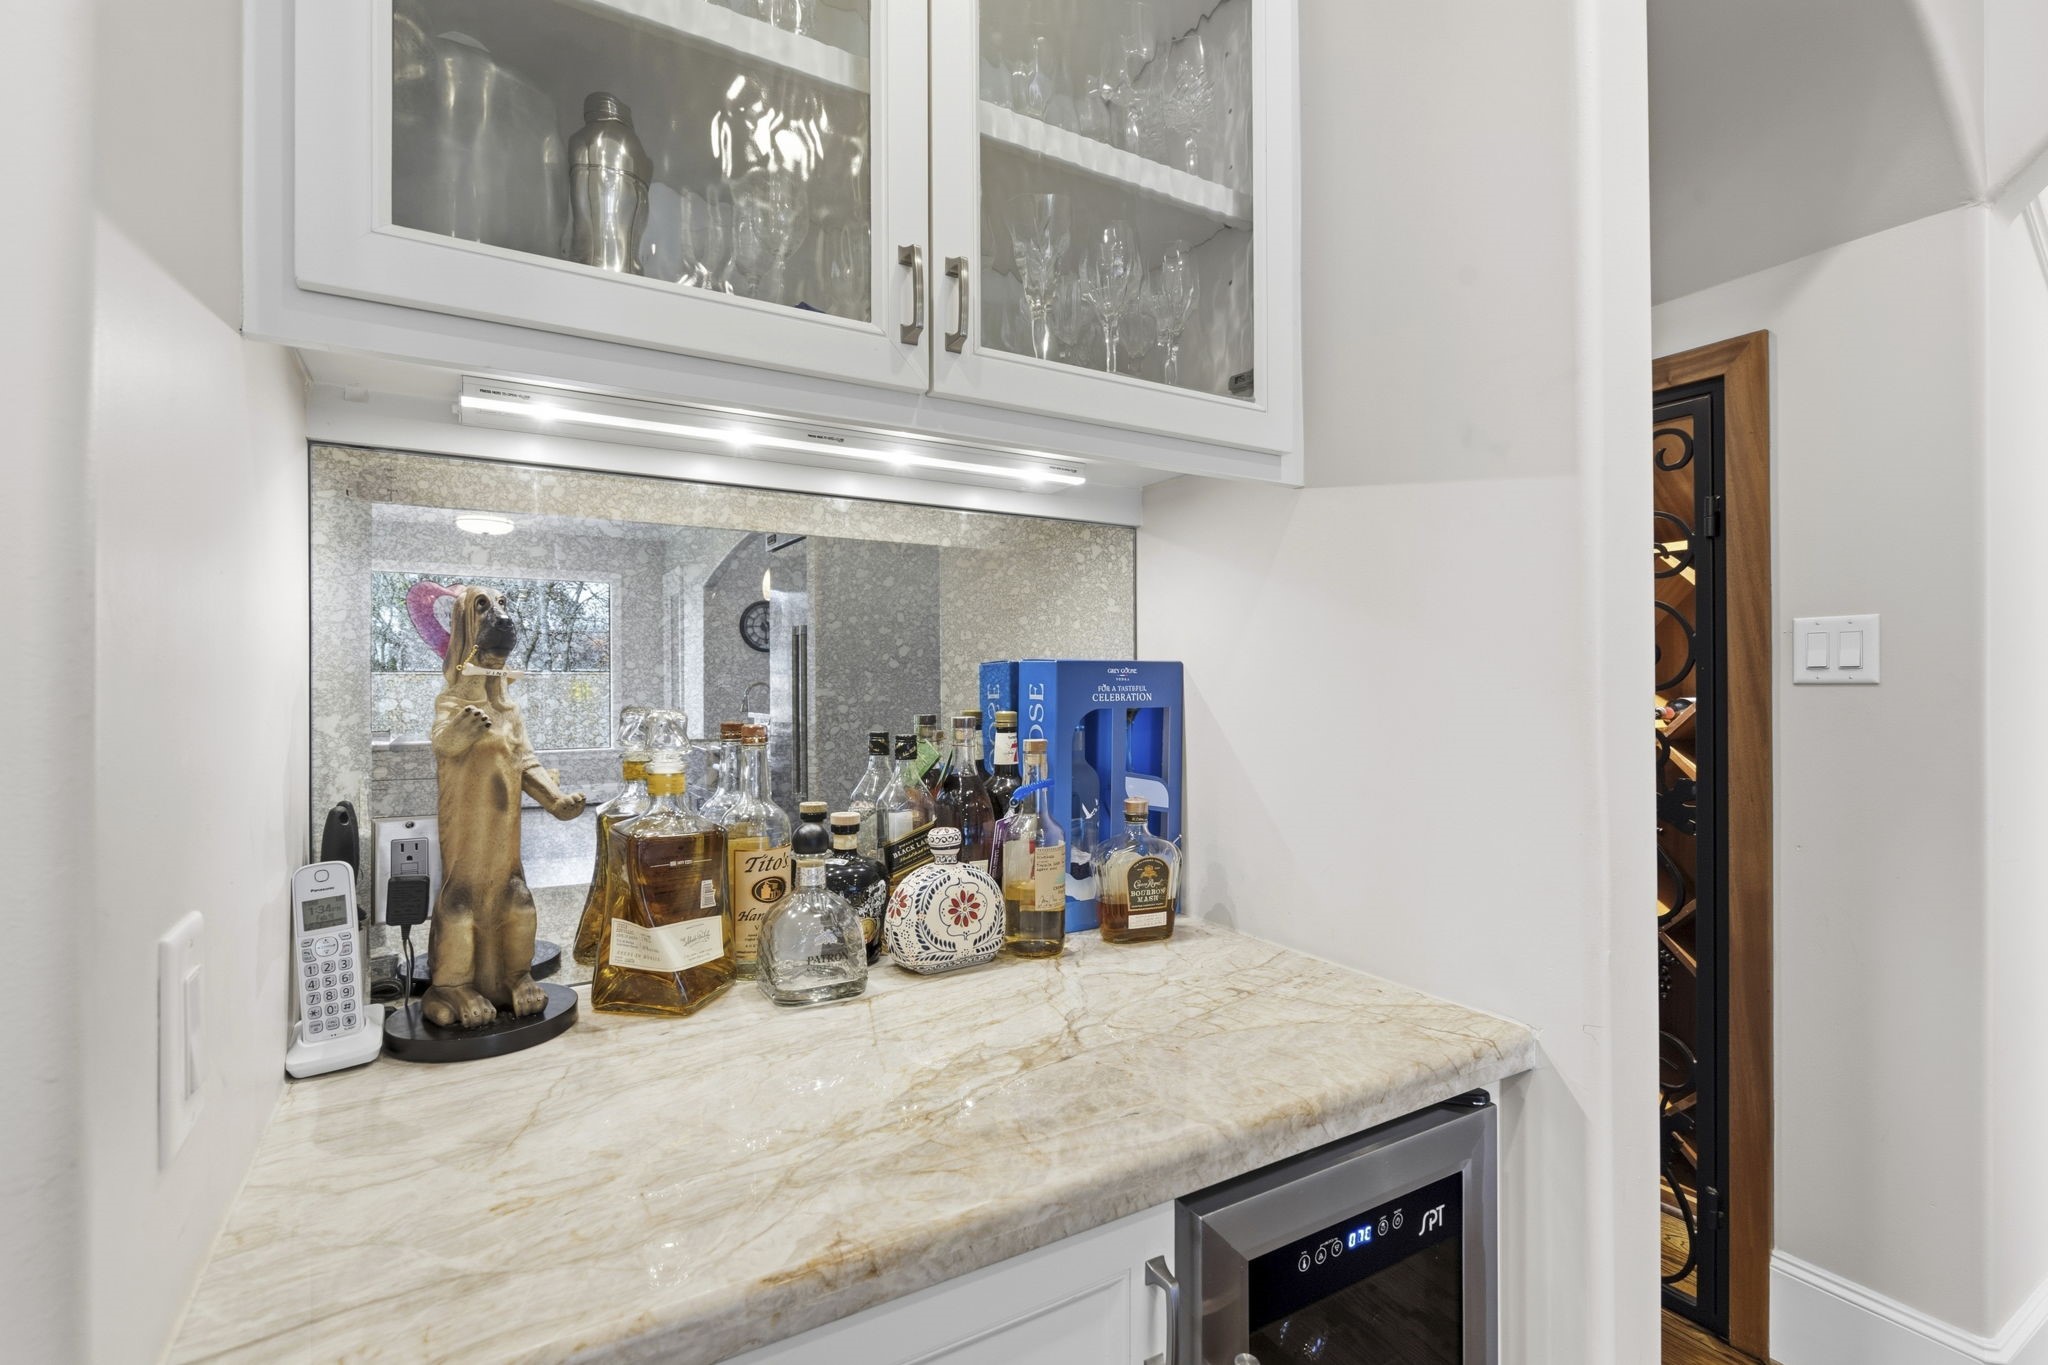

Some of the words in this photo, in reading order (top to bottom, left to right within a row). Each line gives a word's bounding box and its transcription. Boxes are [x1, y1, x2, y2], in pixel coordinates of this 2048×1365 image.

[1098, 684, 1110, 692] FOR
[1092, 692, 1152, 702] CELEBRATION
[892, 844, 915, 859] BLACK
[744, 851, 790, 874] Tito's
[1130, 887, 1166, 897] BOURBON
[307, 966, 312, 975] 1
[324, 963, 331, 972] 2
[341, 960, 347, 969] 3
[308, 980, 314, 989] 4
[325, 977, 332, 986] 5
[342, 974, 348, 983] 6
[310, 994, 315, 1004] 7
[326, 991, 333, 1001] 8
[342, 988, 349, 997] 9
[327, 1005, 333, 1014] 0
[1418, 1204, 1445, 1236] SPT
